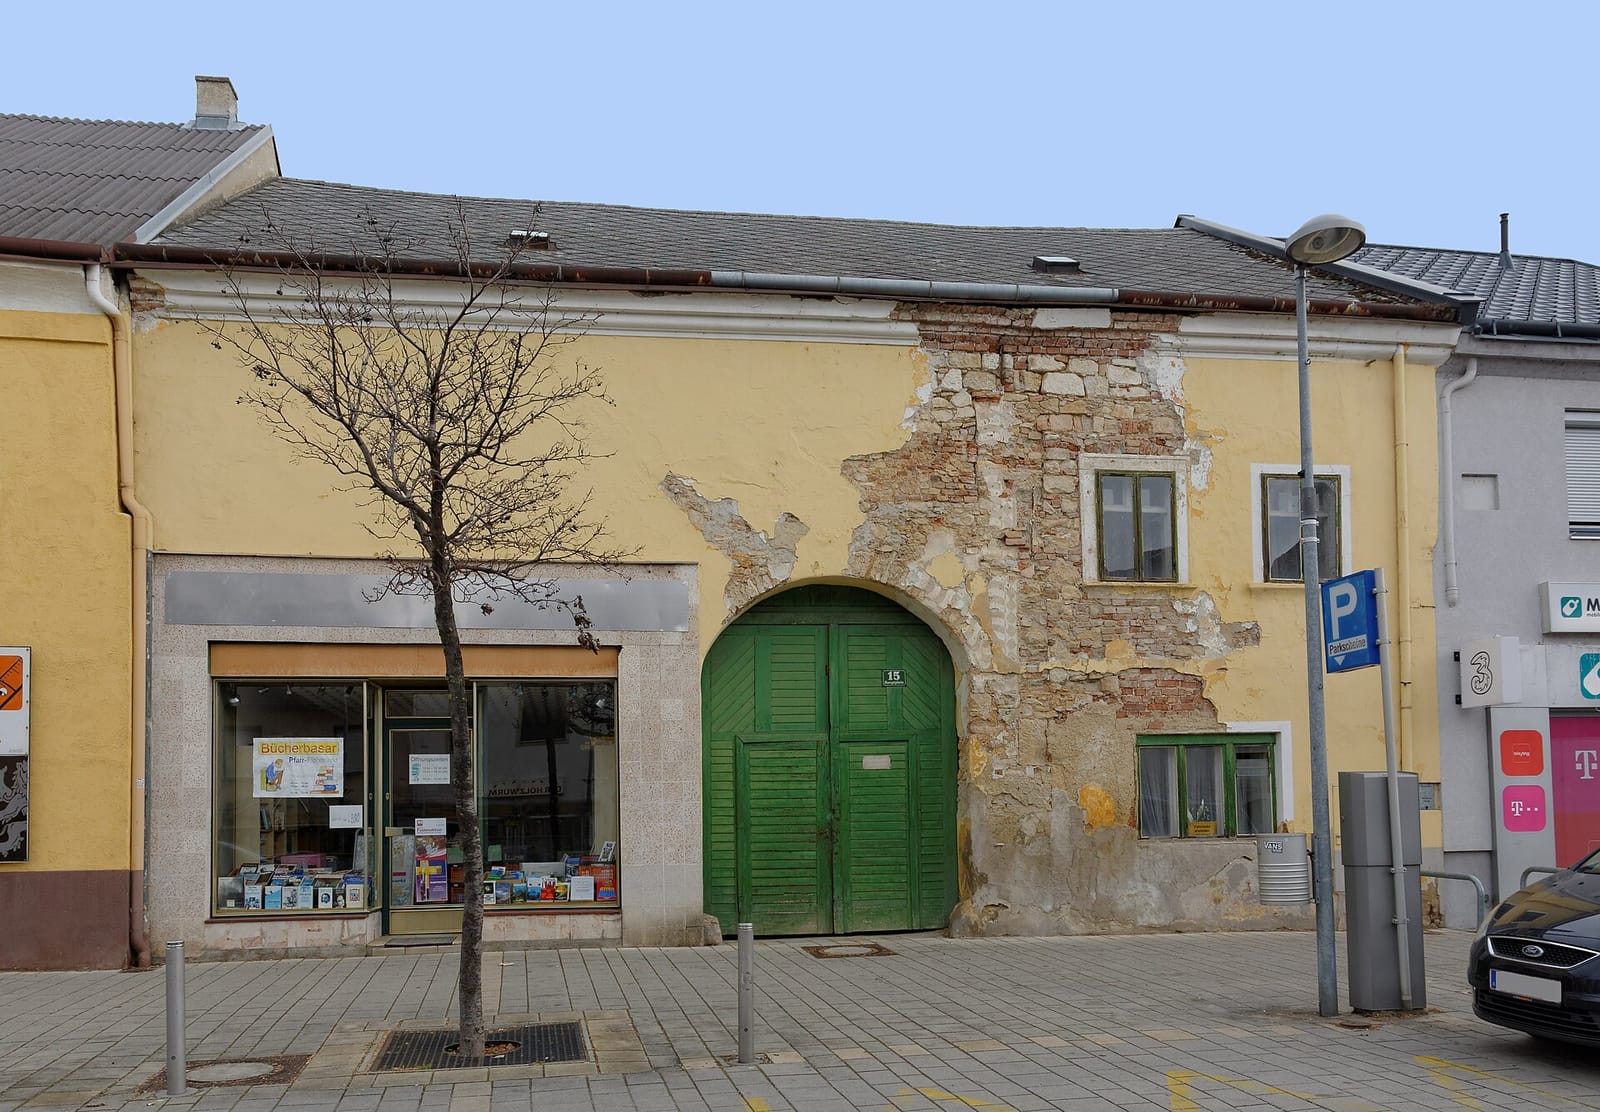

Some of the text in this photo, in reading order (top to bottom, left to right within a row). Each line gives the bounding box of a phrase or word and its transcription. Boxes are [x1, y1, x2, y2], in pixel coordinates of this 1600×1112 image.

[1329, 582, 1357, 640] P
[1329, 638, 1366, 655] Parkscheine
[888, 671, 900, 680] 15
[1471, 651, 1493, 695] 3
[261, 743, 337, 754] Bücherbasar
